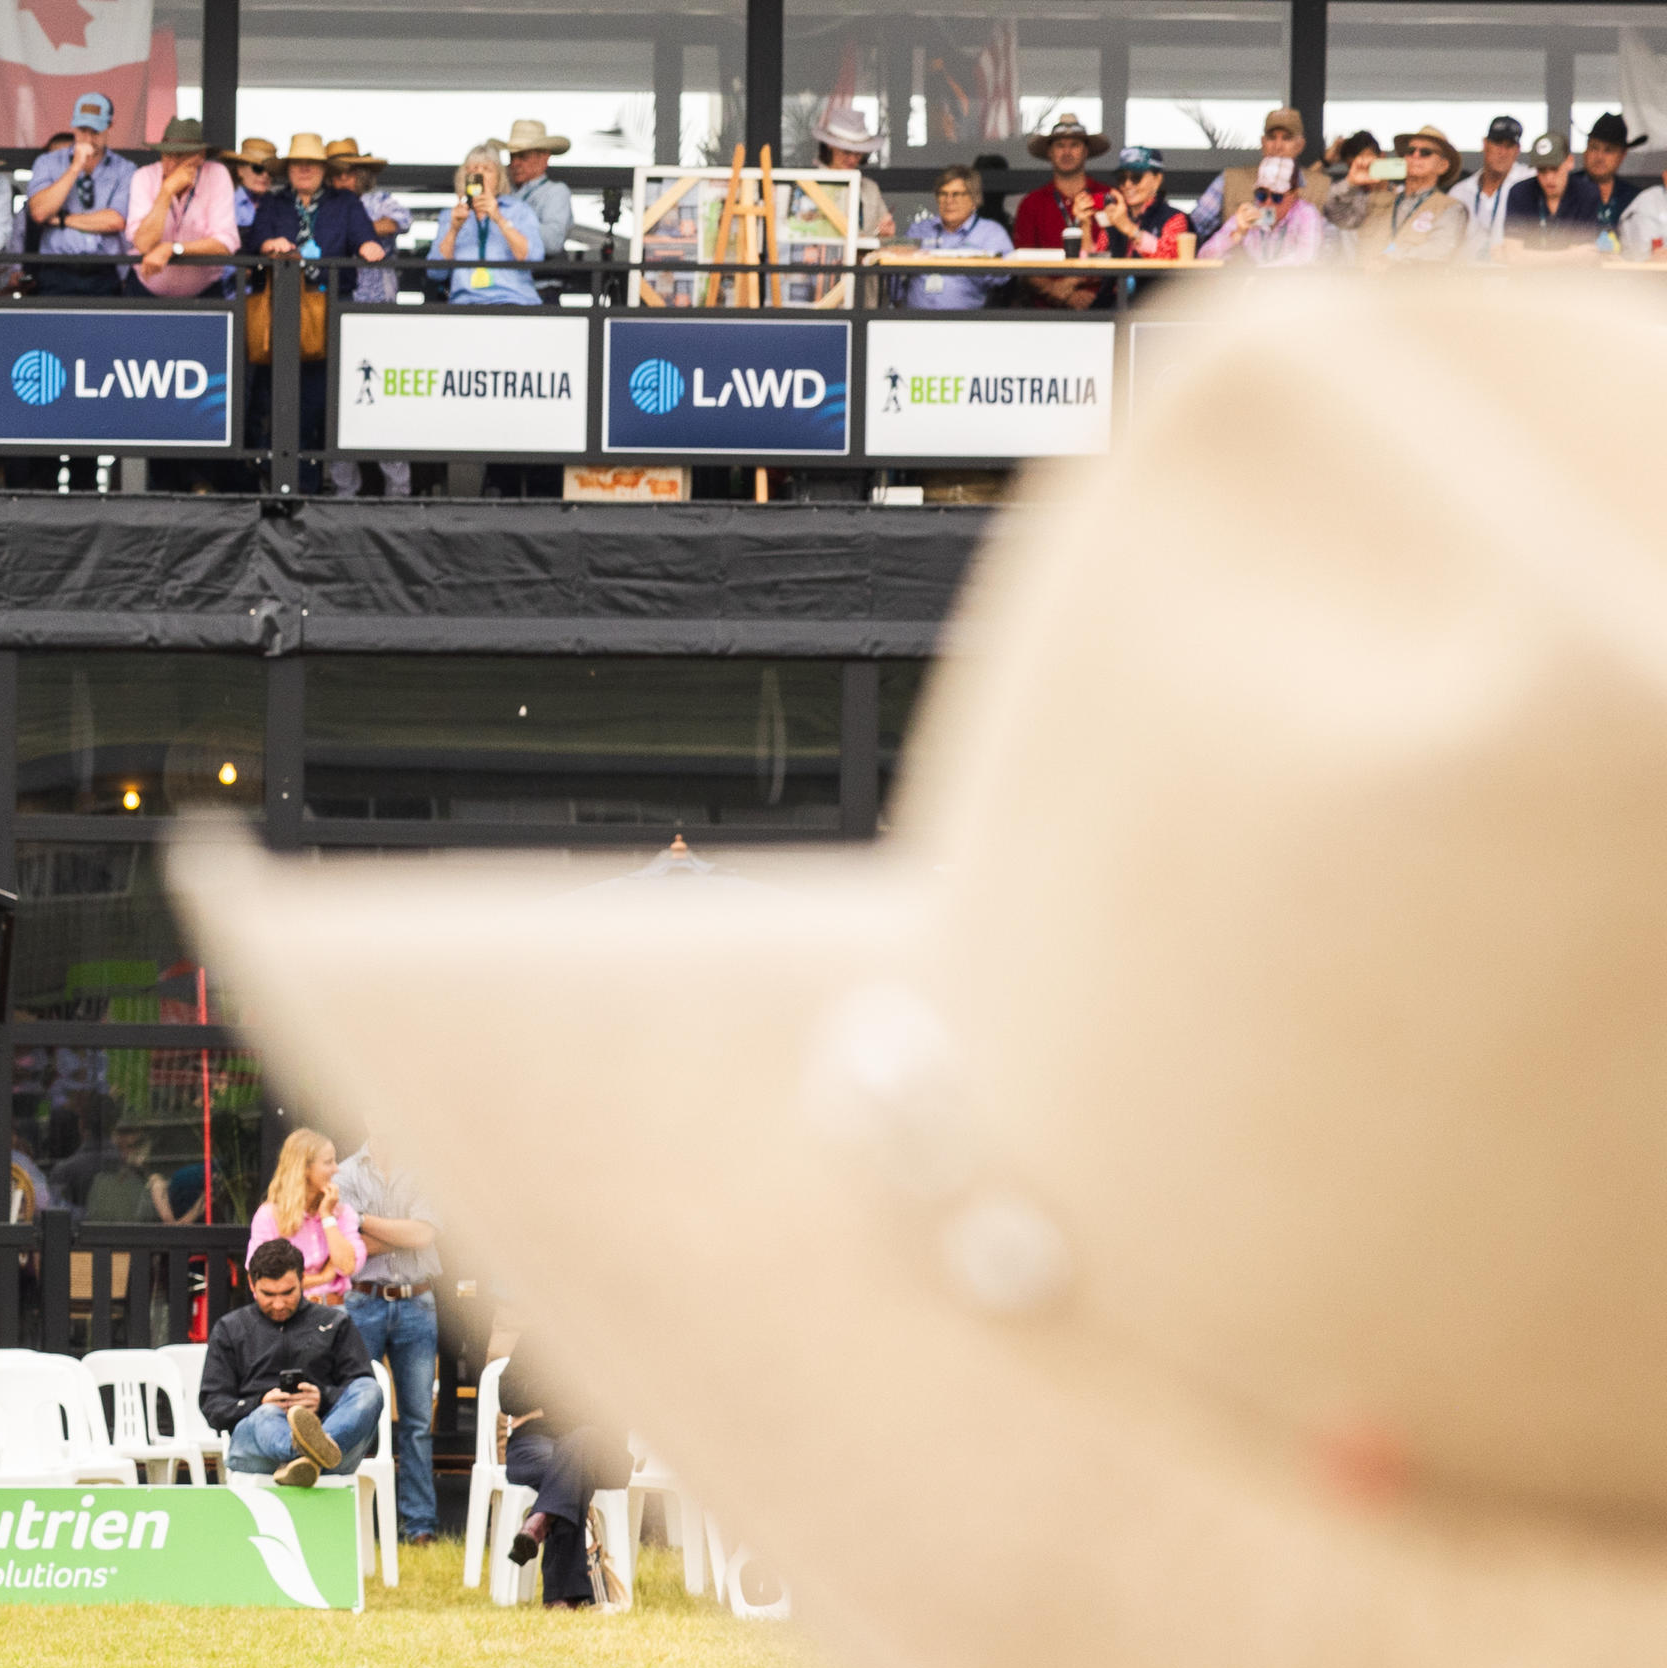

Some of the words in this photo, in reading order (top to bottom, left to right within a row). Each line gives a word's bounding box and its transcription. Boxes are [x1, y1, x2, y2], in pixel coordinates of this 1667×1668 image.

[75, 359, 209, 399] LAWD
[383, 368, 437, 397] BEEF
[442, 370, 571, 399] AUSTRALIA
[692, 368, 827, 409] LAWD
[910, 376, 964, 404] BEEF
[969, 377, 1097, 405] AUSTRALIA
